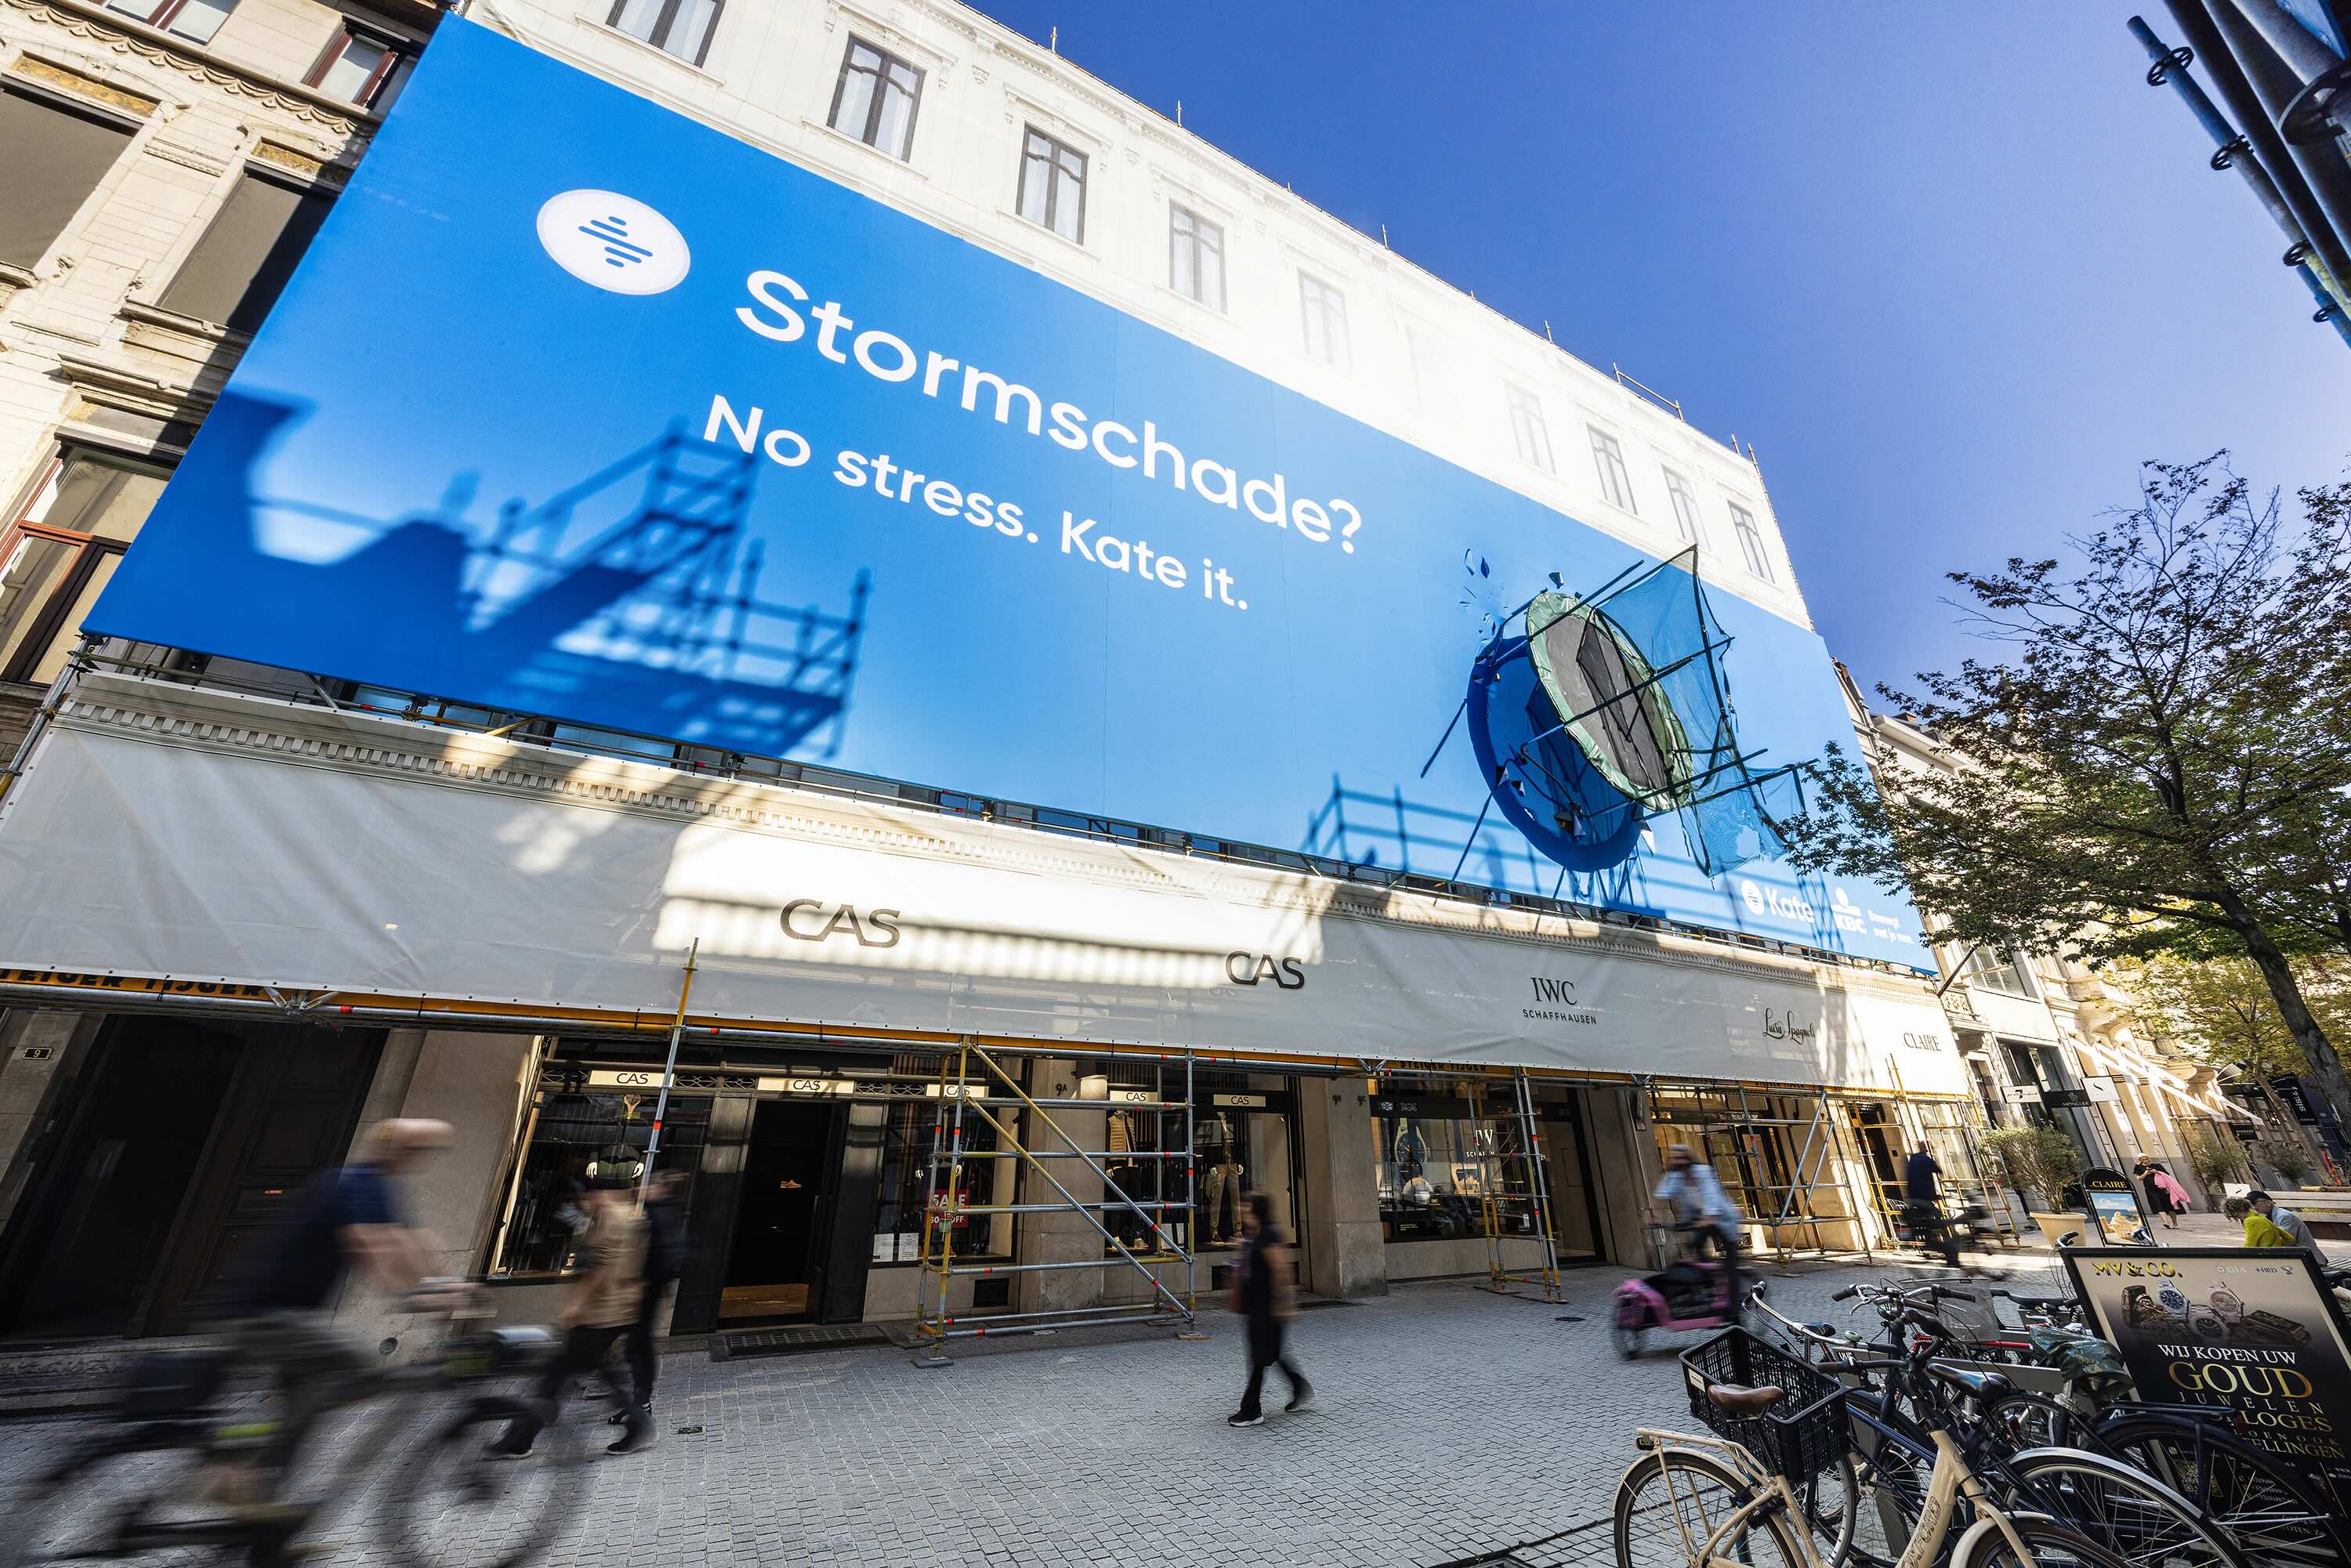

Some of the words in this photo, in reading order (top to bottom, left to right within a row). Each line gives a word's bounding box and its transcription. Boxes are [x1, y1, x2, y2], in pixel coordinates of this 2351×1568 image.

[735, 270, 1362, 554] Stormschade?
[703, 394, 810, 468] No
[833, 449, 1039, 543] stress.
[1062, 511, 1187, 588] Kate
[1203, 559, 1248, 610] it.
[1765, 887, 1816, 924] Kate
[780, 898, 900, 948] CAS
[1835, 913, 1867, 934] KBC
[1226, 951, 1306, 990] CAS
[1530, 977, 1578, 1005] IWC
[1523, 1009, 1597, 1025] SCHAFFHAUSEN
[1762, 1008, 1785, 1039] Luisa
[1904, 1032, 1942, 1052] CLAIRE
[33, 1049, 41, 1058] 9
[616, 1072, 649, 1085] CAS
[793, 1080, 820, 1091] CAS
[1126, 1092, 1147, 1102] CAS
[1230, 1095, 1249, 1105] CAS
[933, 1193, 965, 1208] SAE
[2157, 1344, 2189, 1358] WIJ
[2193, 1346, 2259, 1362] KOPEN
[2261, 1350, 2296, 1364] UW
[2168, 1360, 2313, 1399] GOUD
[2179, 1391, 2324, 1414] JUWELEN
